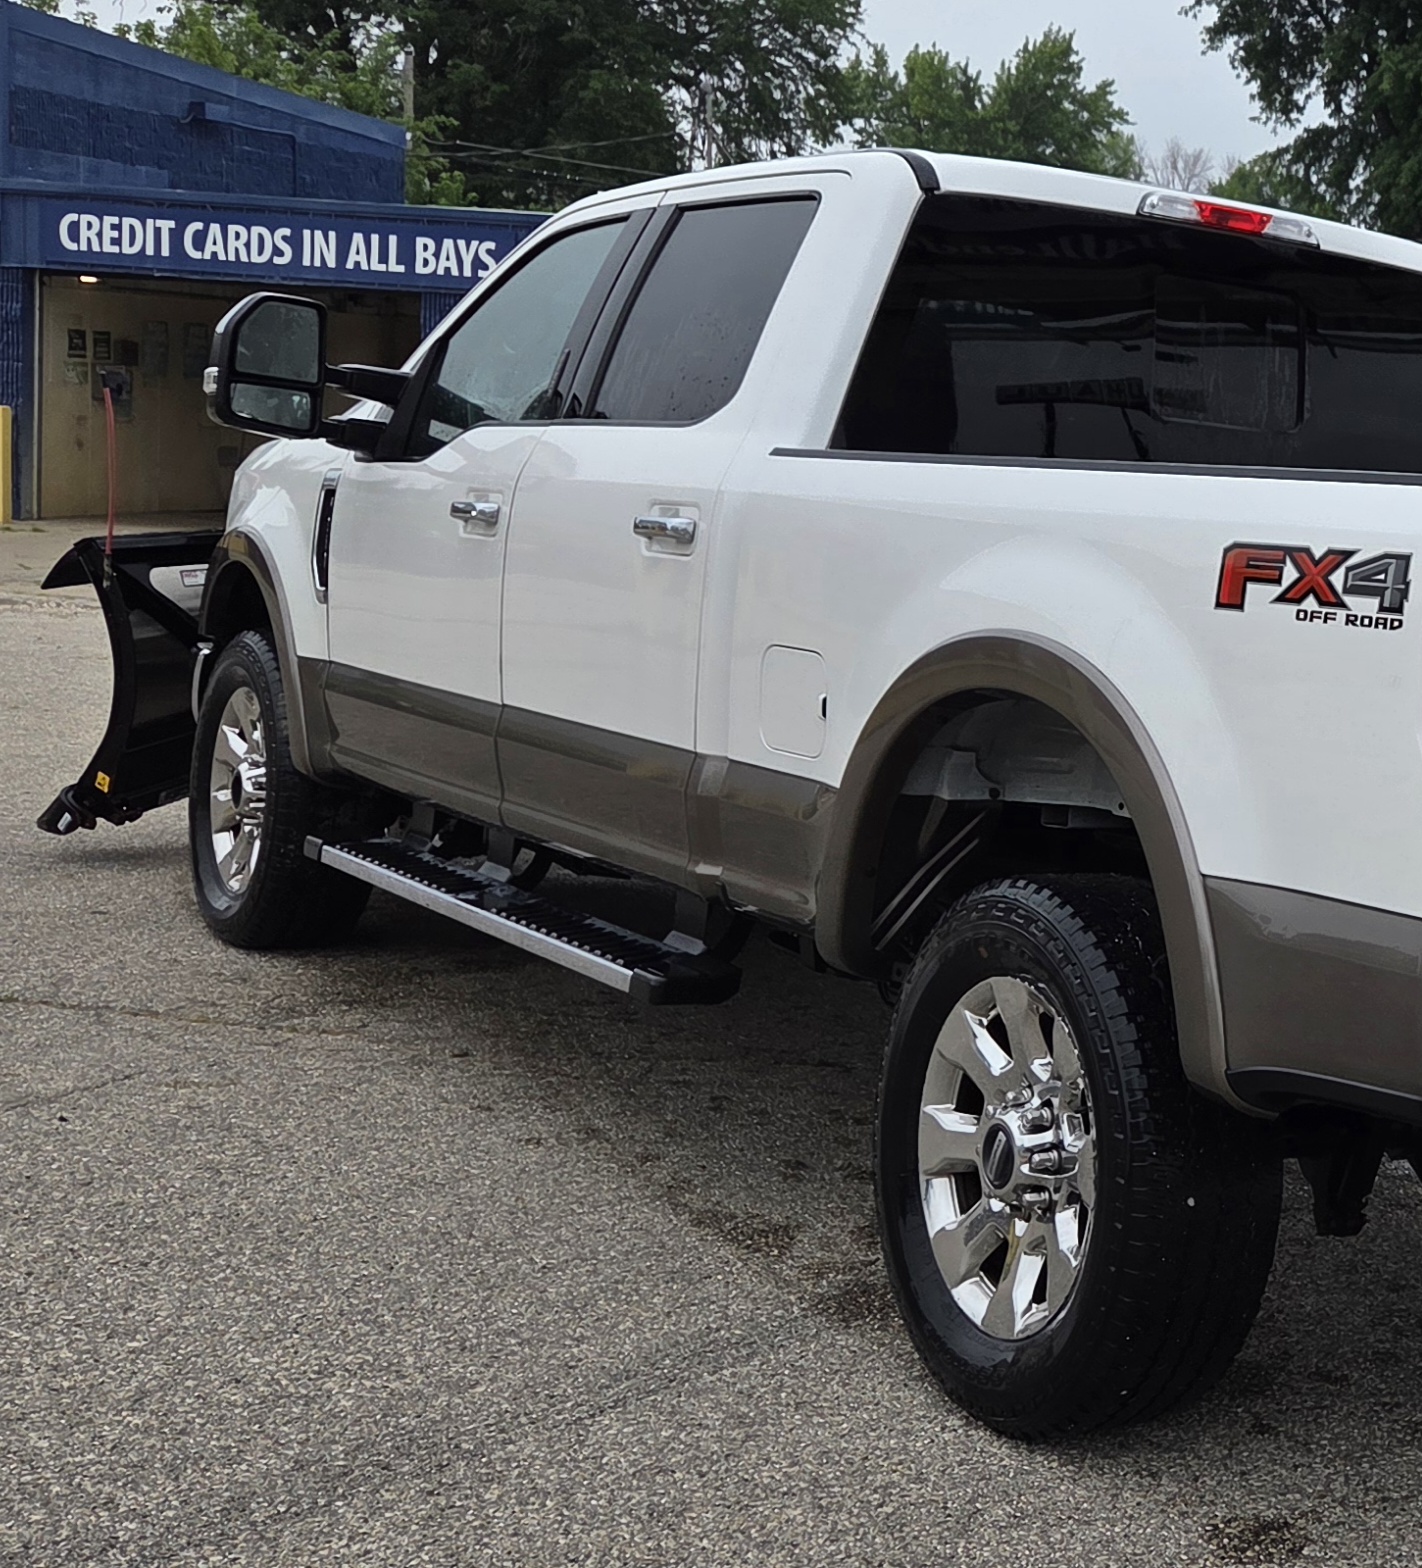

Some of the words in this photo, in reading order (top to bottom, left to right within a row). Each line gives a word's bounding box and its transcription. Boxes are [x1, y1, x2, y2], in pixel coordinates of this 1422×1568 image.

[59, 213, 176, 257] CREDIT
[184, 222, 292, 265] CARDS
[302, 229, 337, 268] IN
[345, 232, 405, 273] ALL
[415, 236, 497, 278] BAYS
[1215, 541, 1412, 616] FX4
[1295, 609, 1337, 625] OFF
[1344, 613, 1404, 631] ROAD
